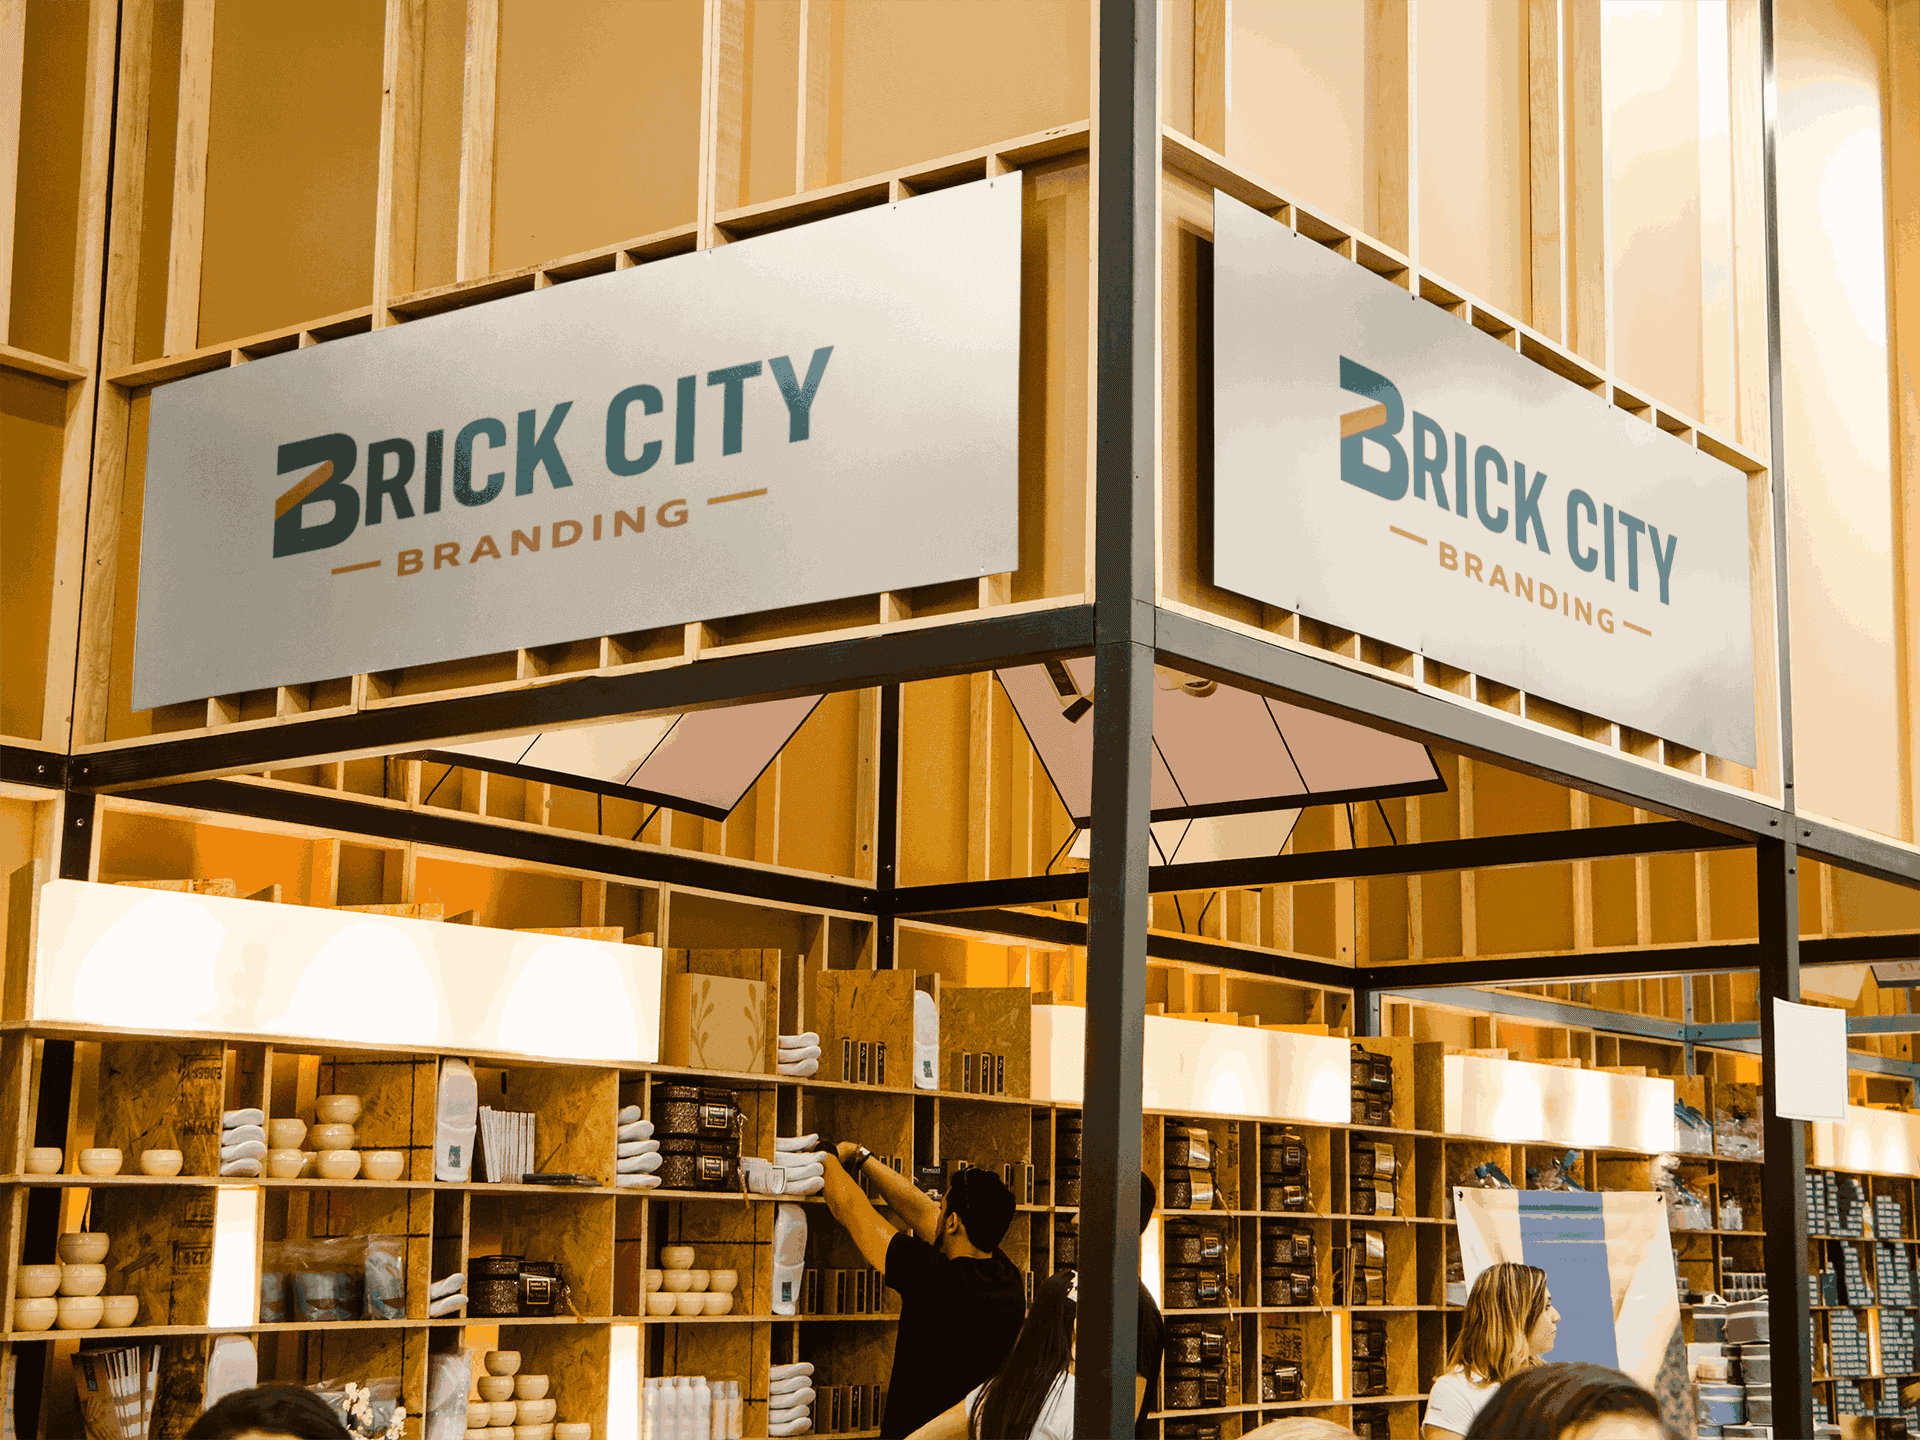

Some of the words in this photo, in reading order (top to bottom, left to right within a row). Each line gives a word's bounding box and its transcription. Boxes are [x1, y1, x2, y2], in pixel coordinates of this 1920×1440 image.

[273, 400, 574, 559] BRICK
[604, 345, 834, 477] CITY
[1339, 354, 1551, 555] BRICK
[1566, 488, 1677, 606] CITY
[397, 498, 689, 577] BRANDING
[1439, 541, 1614, 634] BRANDING
